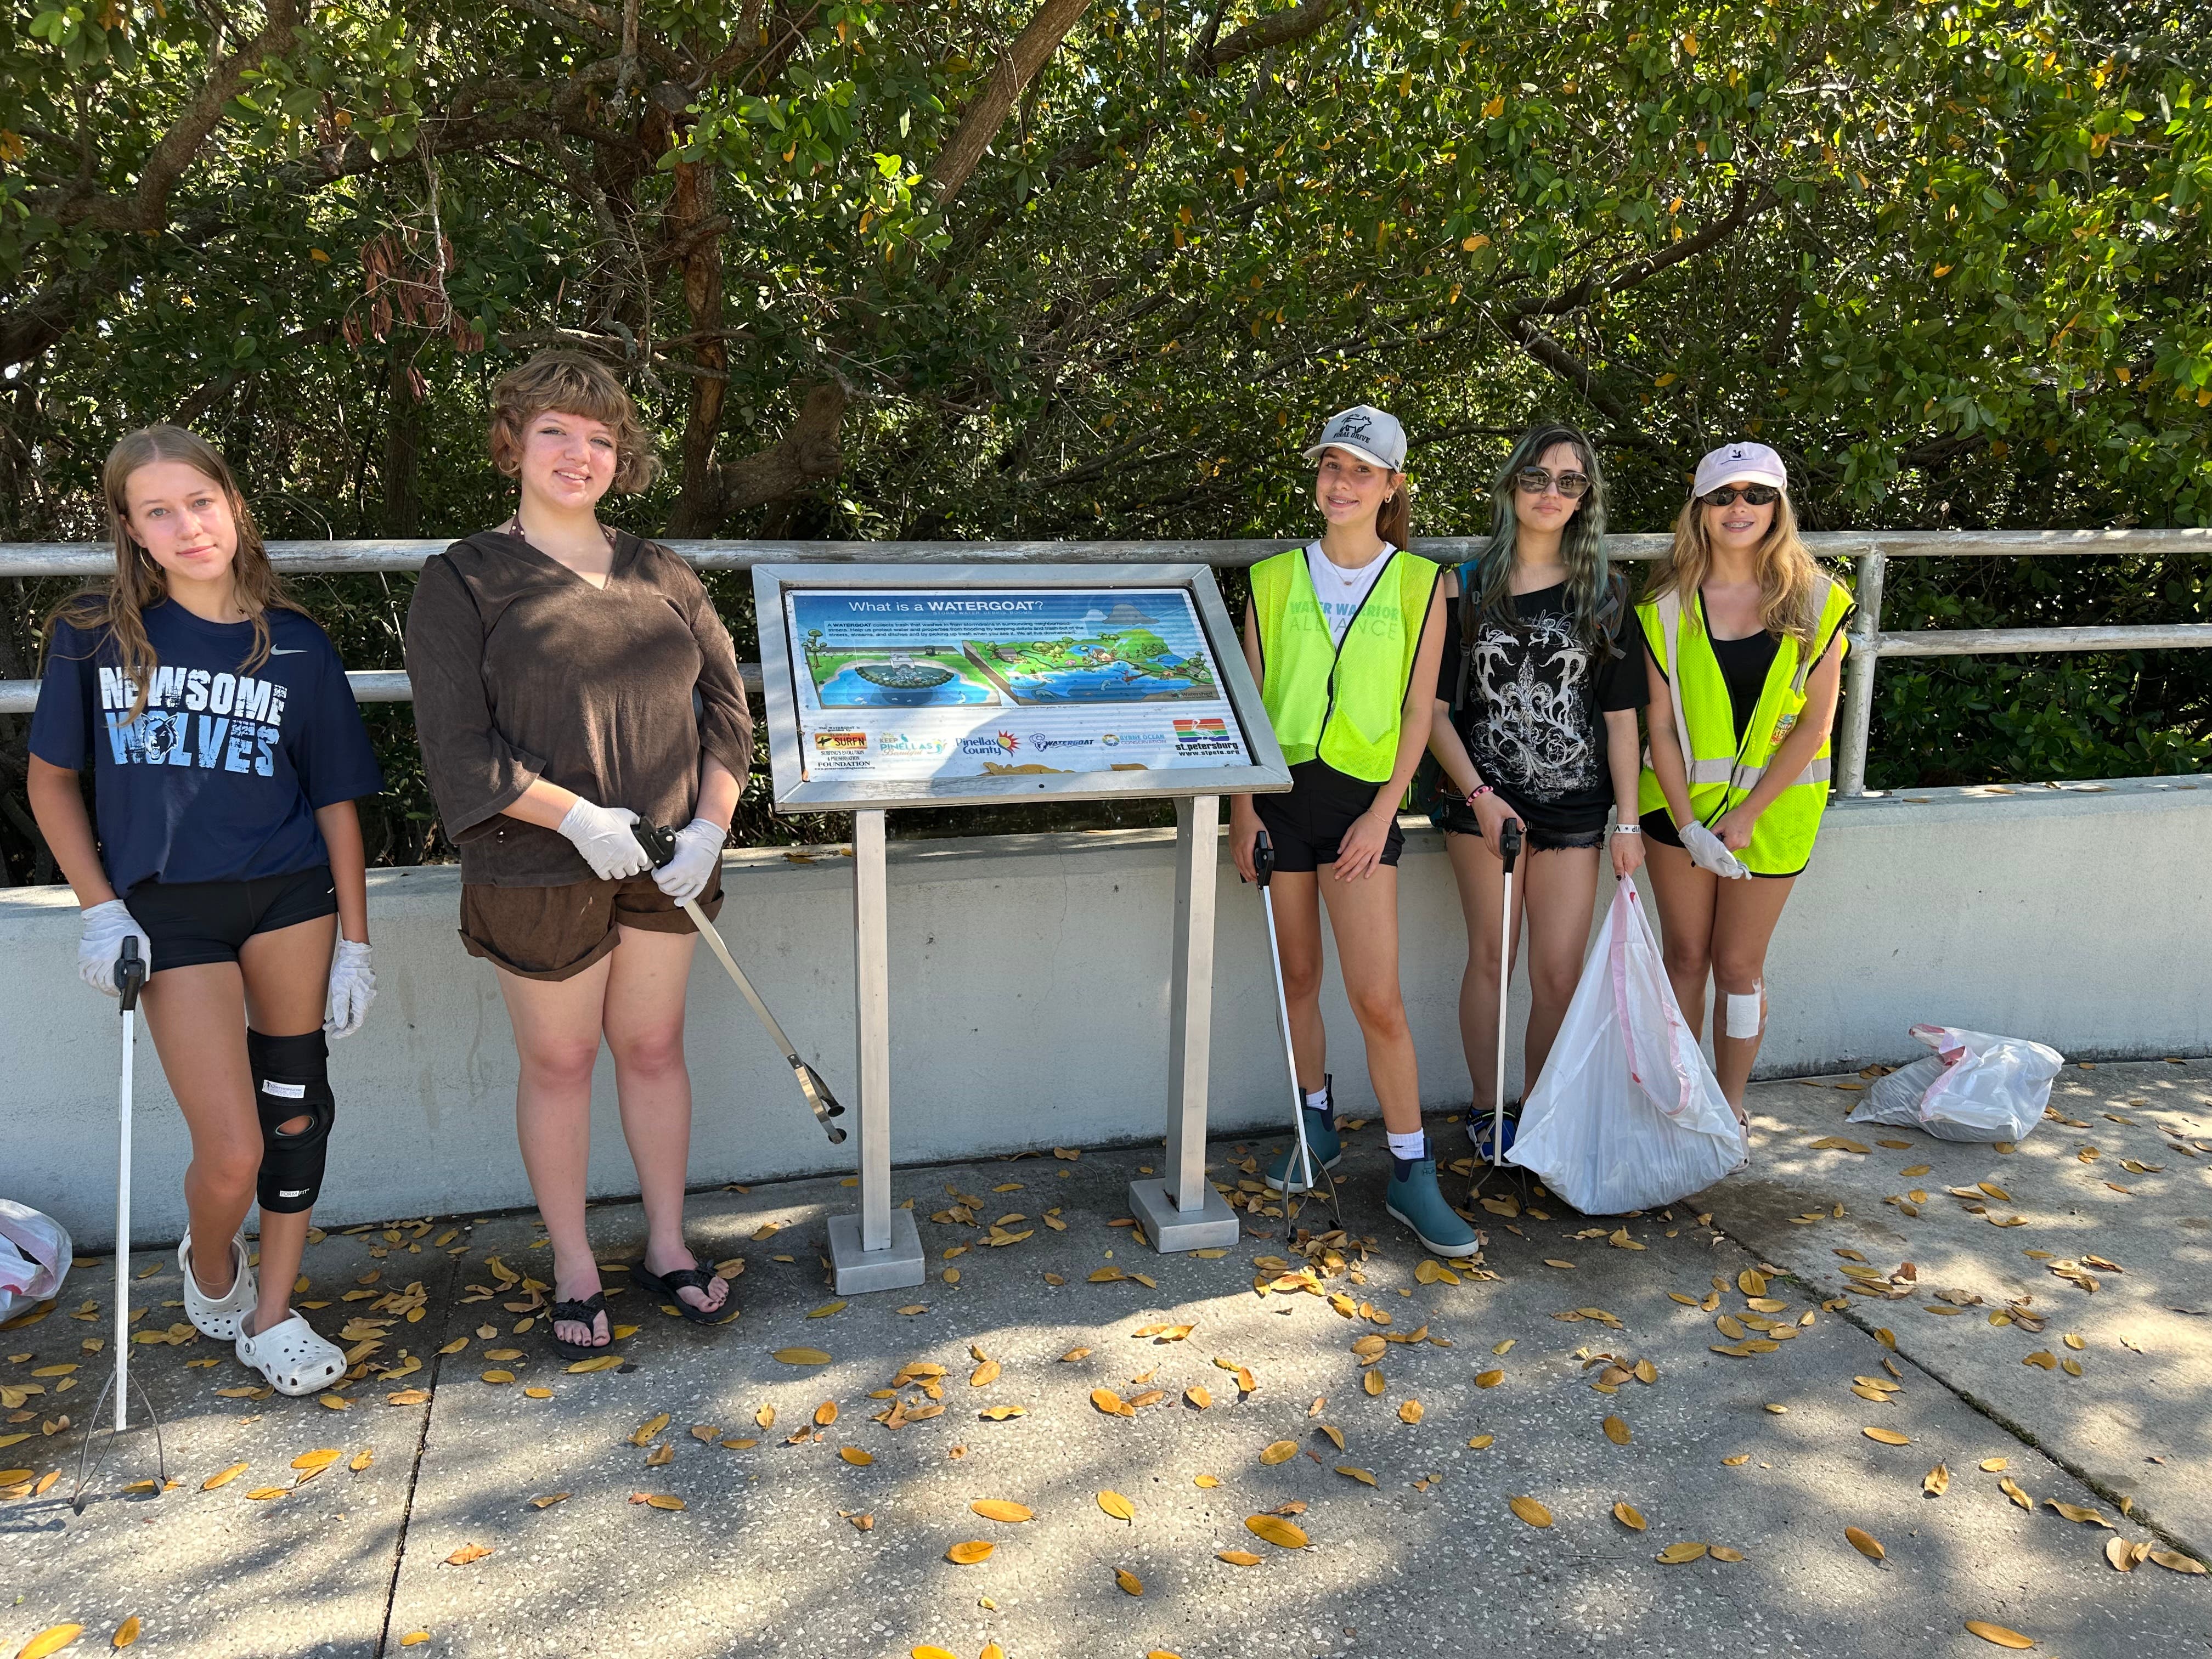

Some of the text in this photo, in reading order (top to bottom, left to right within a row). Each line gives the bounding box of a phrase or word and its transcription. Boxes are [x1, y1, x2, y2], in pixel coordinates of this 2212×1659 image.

[849, 602, 891, 611] What
[896, 602, 909, 611] is
[927, 601, 1043, 611] WATERGOAT?
[99, 665, 287, 726] NEWSOME
[104, 711, 281, 776] WOLVES
[880, 742, 932, 751] PINELLAS
[955, 737, 996, 747] Pinellas
[963, 745, 1001, 755] County
